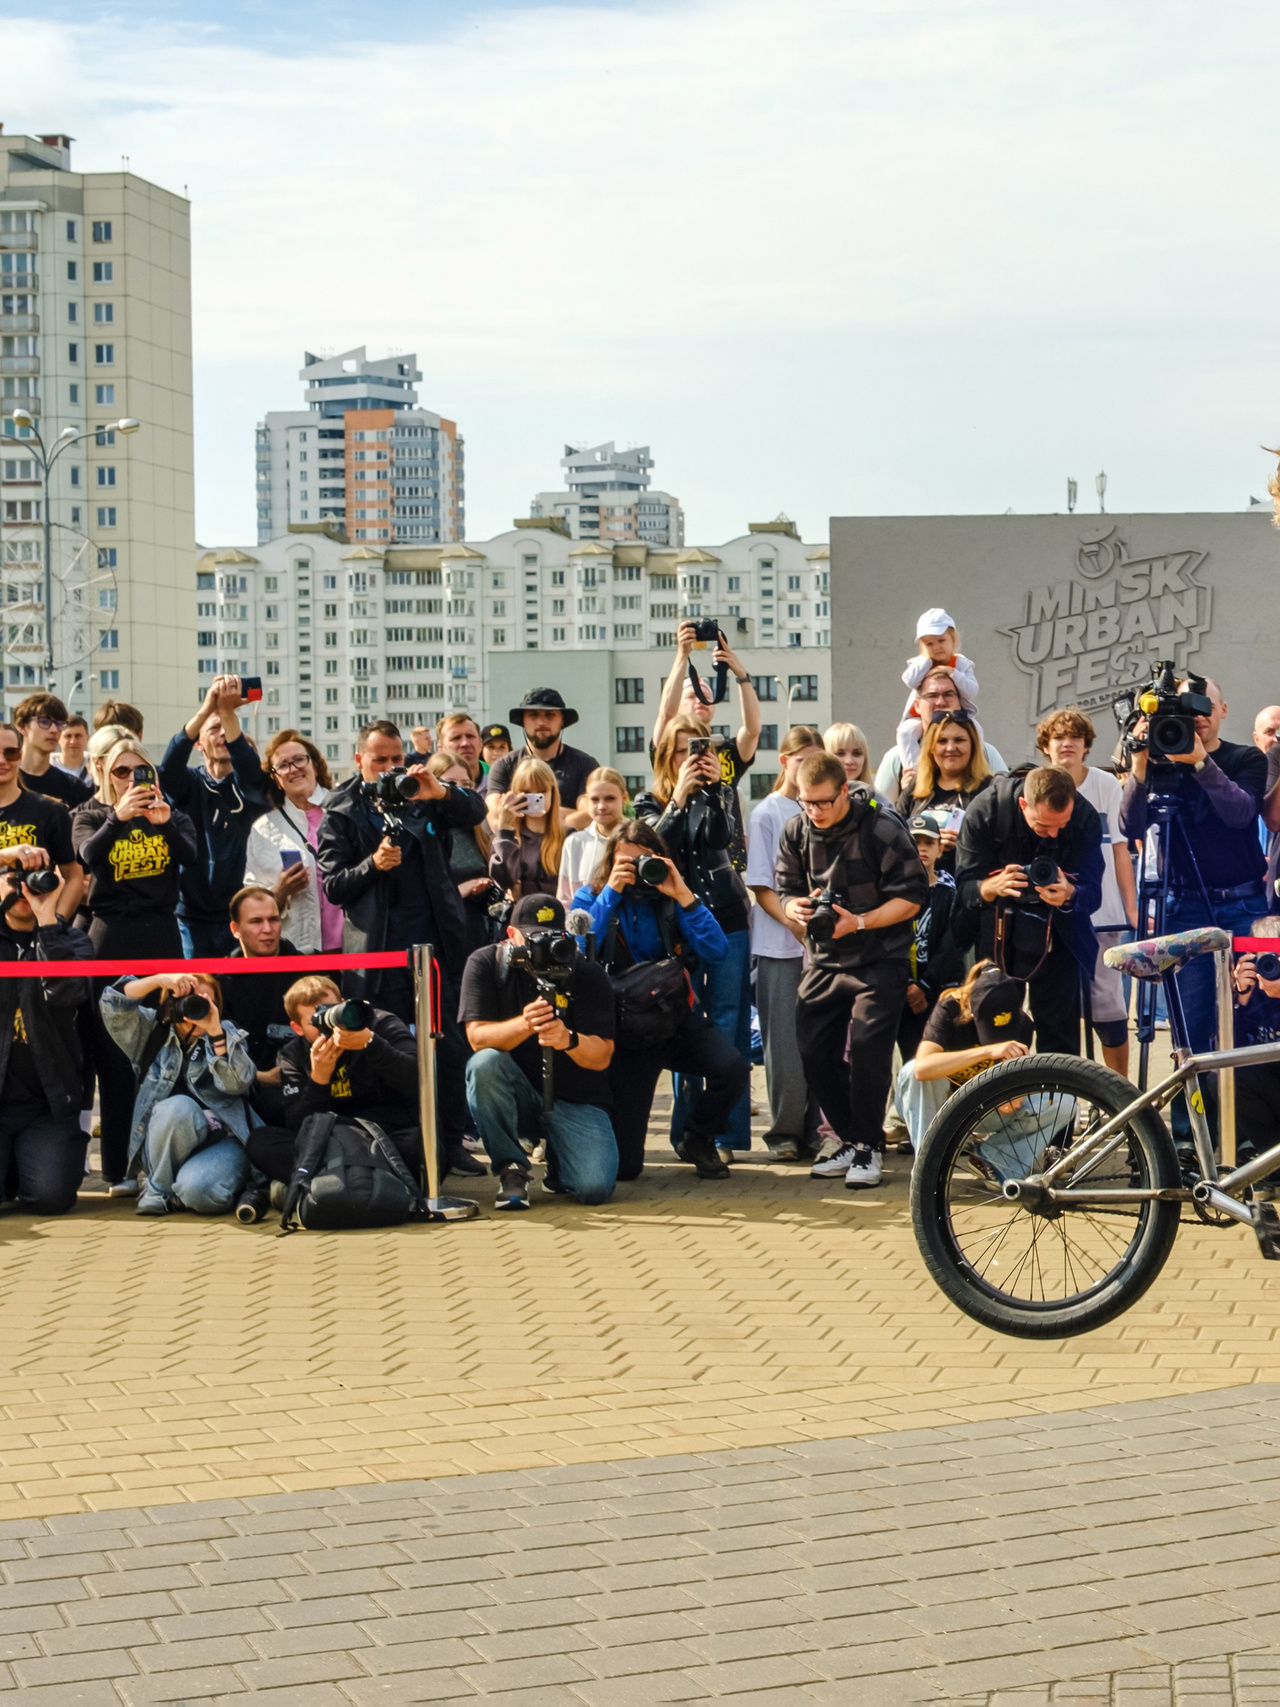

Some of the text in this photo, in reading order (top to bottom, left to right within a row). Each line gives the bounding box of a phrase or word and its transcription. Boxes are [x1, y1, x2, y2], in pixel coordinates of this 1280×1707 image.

[1030, 554, 1194, 625] MINSK
[1010, 588, 1198, 664] URBAN
[1039, 629, 1187, 712] FEST
[111, 845, 168, 863] URBAN
[119, 856, 165, 878] FEST
